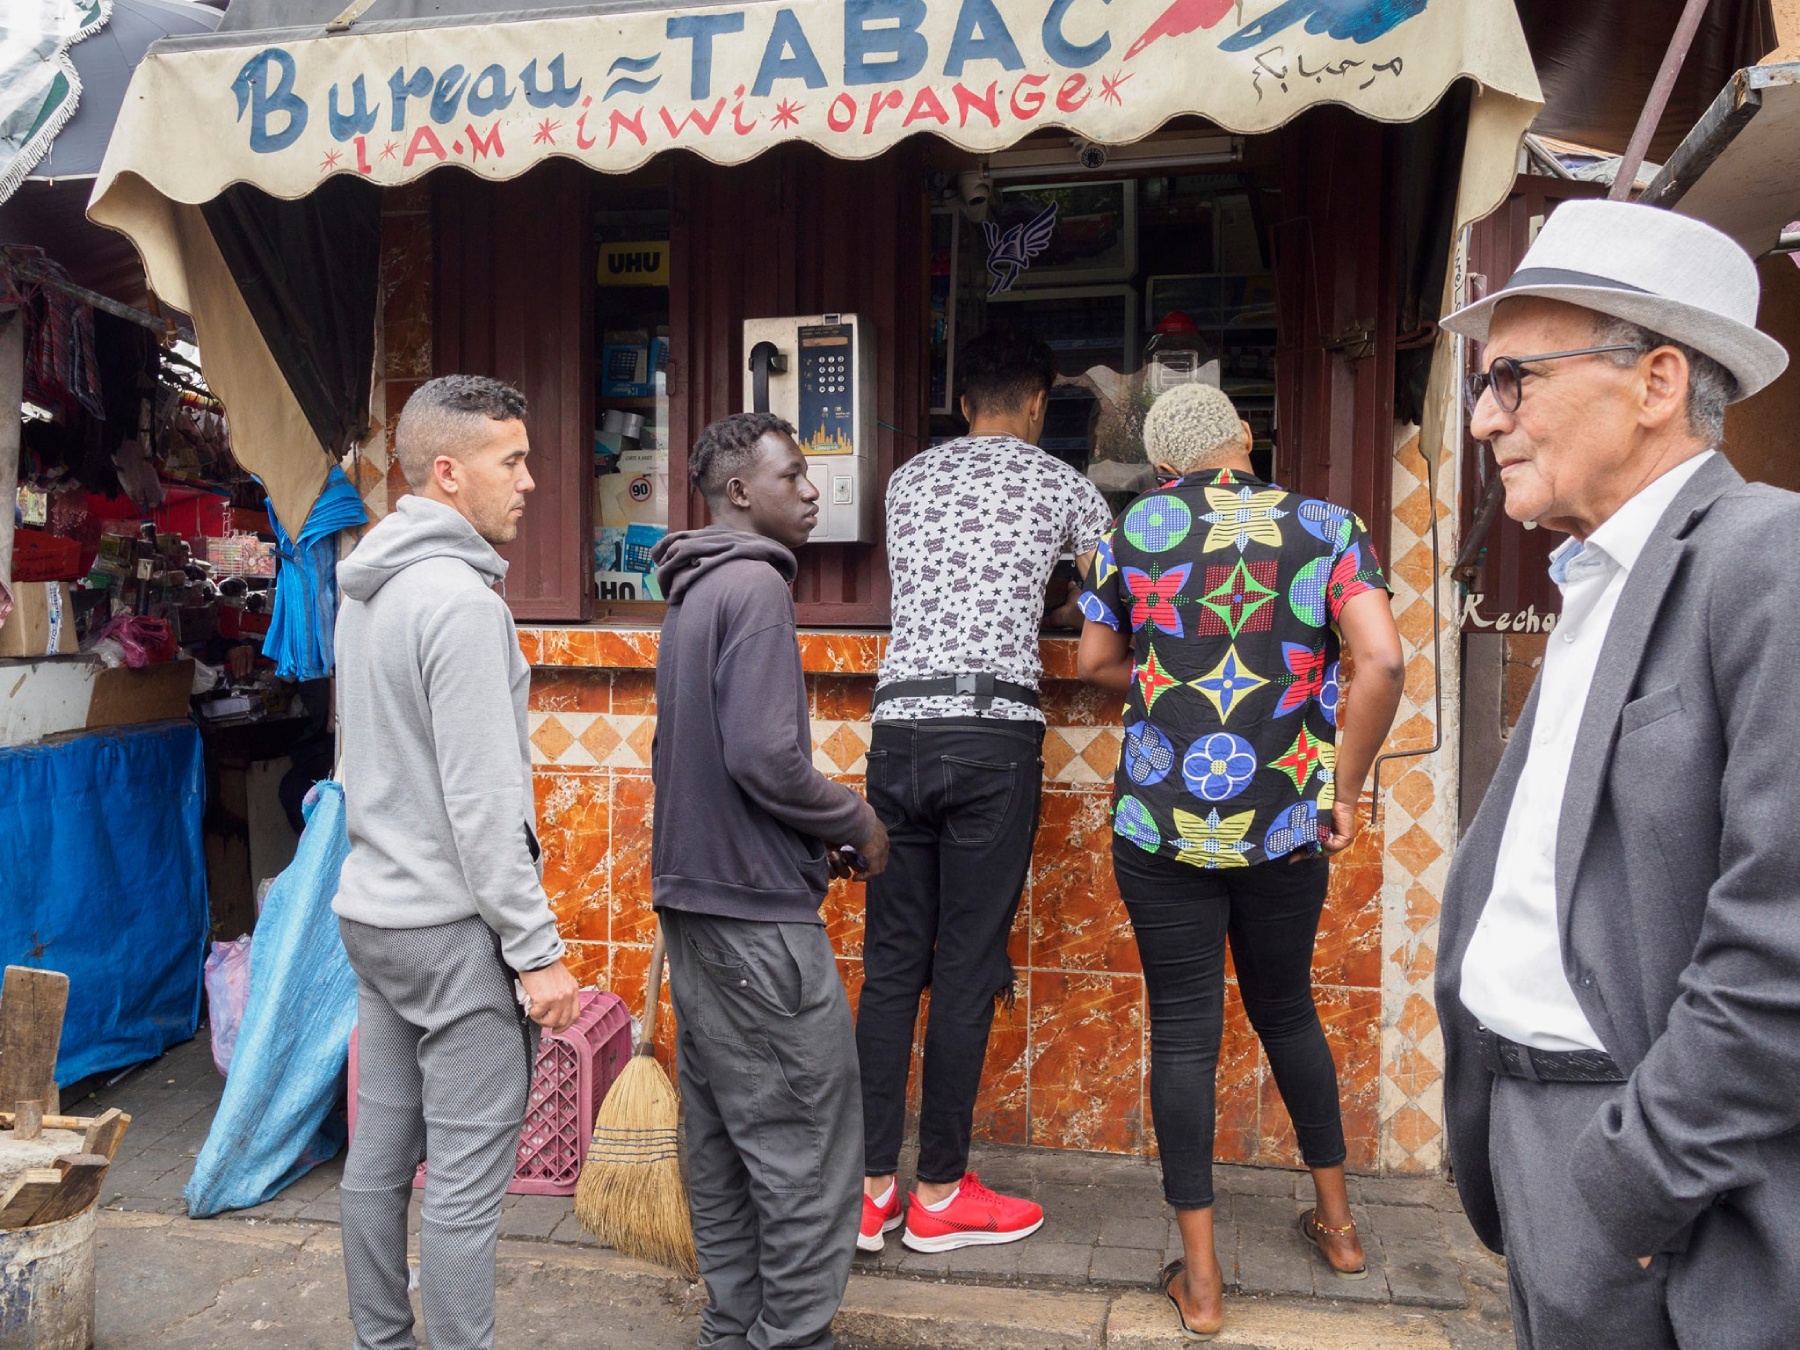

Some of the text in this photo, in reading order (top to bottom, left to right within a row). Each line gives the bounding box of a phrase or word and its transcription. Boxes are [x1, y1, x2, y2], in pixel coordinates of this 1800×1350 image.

[230, 0, 1111, 154] Bureau TABAC
[608, 252, 661, 274] UHU
[632, 483, 648, 497] 90
